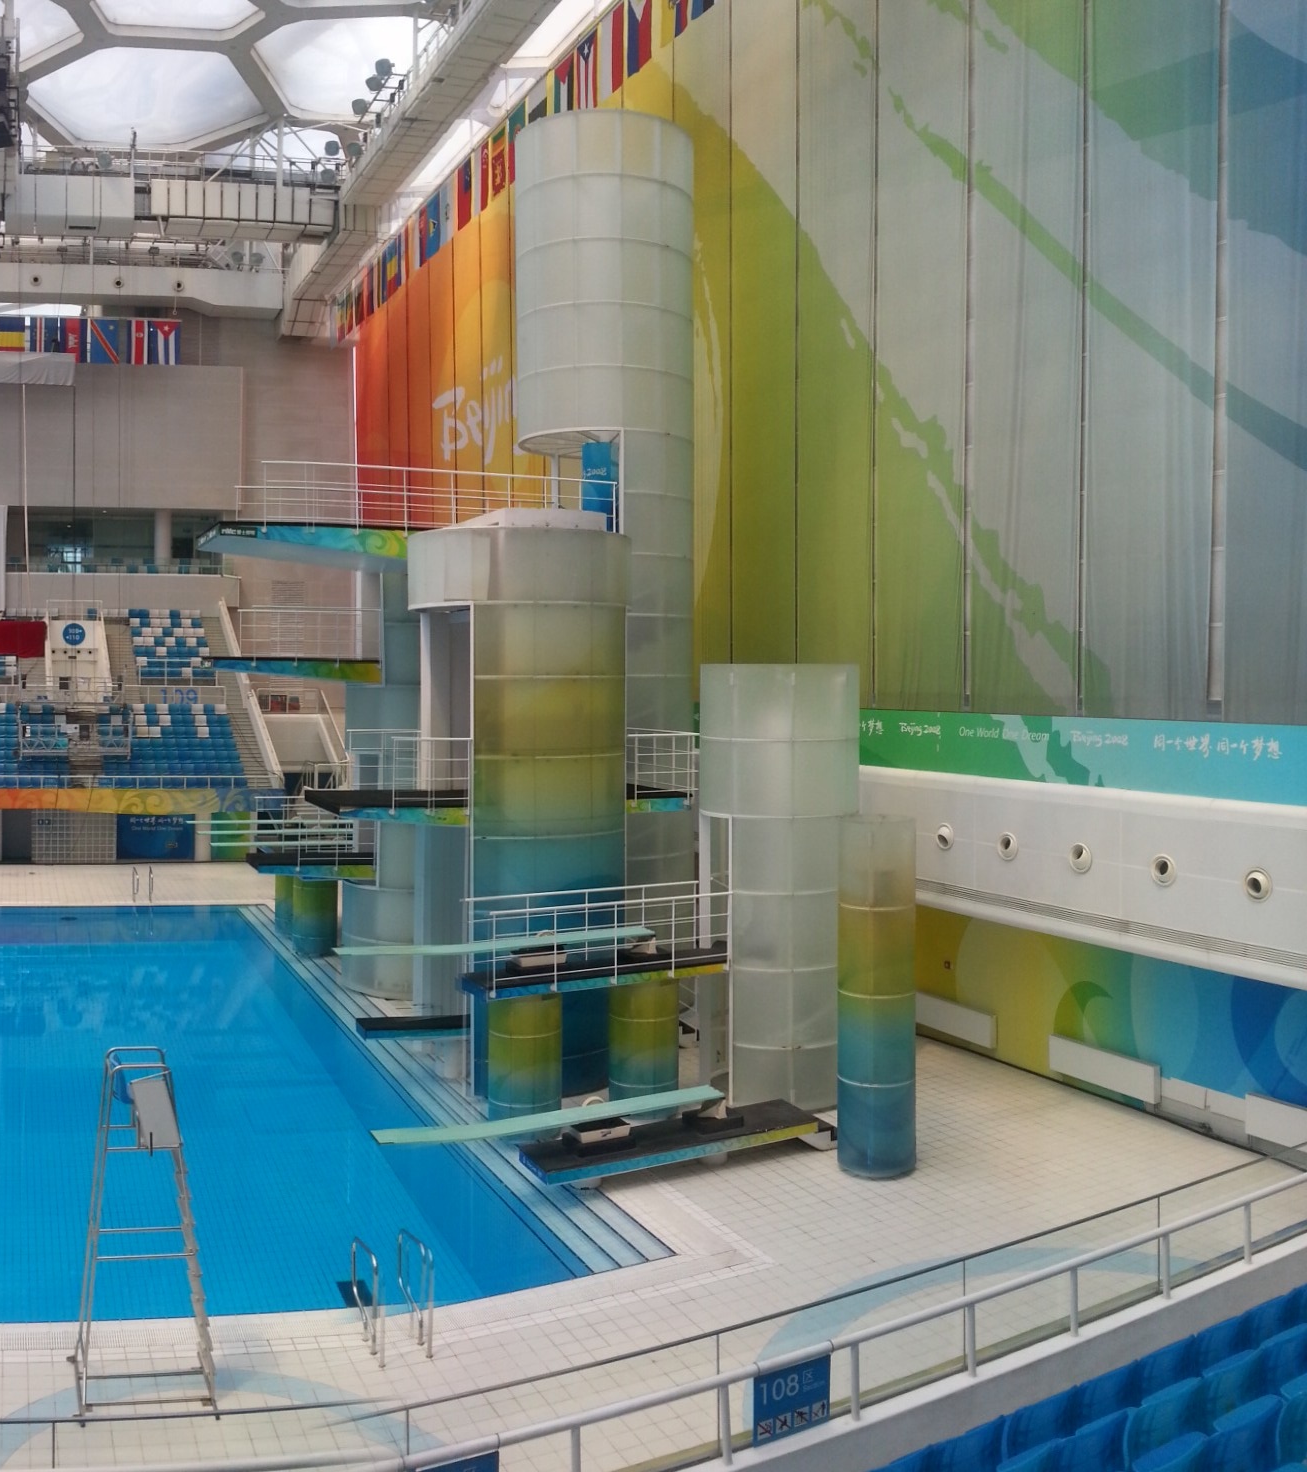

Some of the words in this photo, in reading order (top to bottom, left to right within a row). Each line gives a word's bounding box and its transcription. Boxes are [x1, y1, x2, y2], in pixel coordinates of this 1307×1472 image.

[432, 356, 525, 465] Beijin
[899, 722, 923, 736] Beijing
[923, 724, 941, 735] 2008
[959, 726, 975, 737] One
[977, 727, 999, 739] World
[1002, 728, 1018, 740] One
[1021, 729, 1050, 742] Dream
[1069, 730, 1103, 747] Beijing
[1105, 733, 1129, 746] 2008
[1154, 733, 1212, 759] 同一个世界
[1217, 736, 1283, 761] 同一个梦想
[760, 1373, 799, 1406] 108
